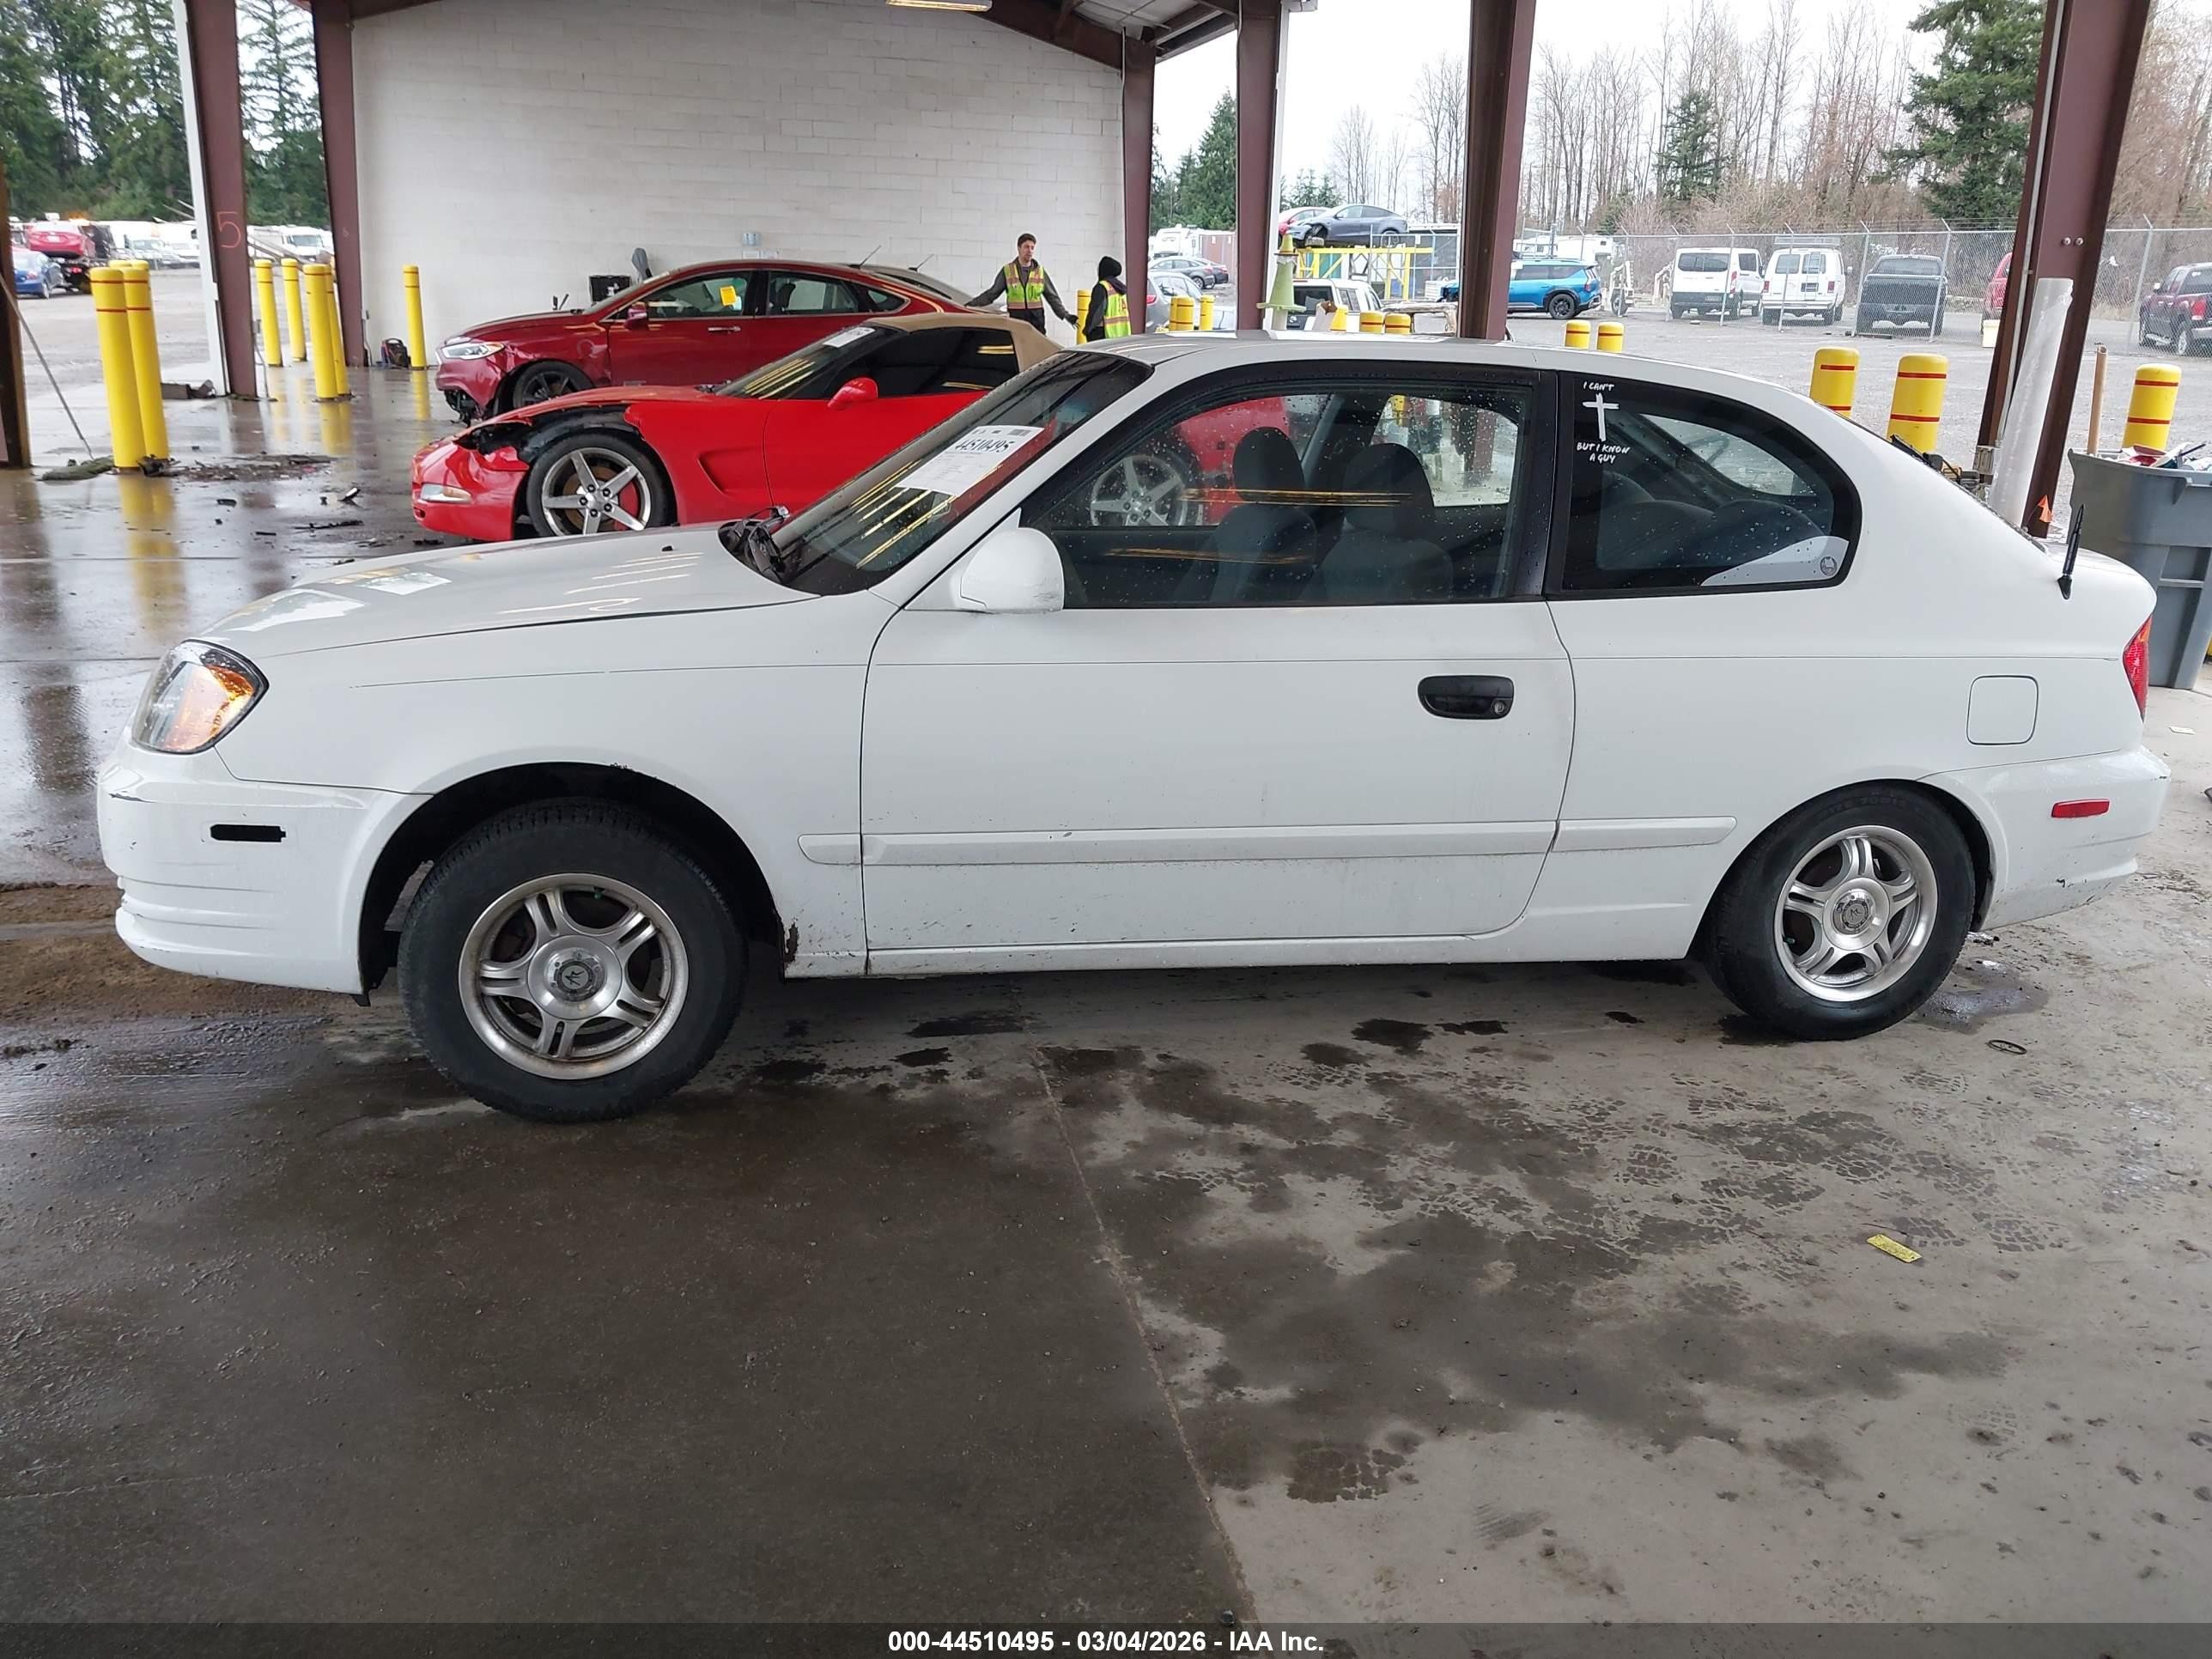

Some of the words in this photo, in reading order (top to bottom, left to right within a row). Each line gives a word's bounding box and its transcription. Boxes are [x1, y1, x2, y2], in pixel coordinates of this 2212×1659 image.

[216, 210, 241, 248] 5
[1589, 382, 1614, 391] CAN'T
[1577, 442, 1595, 451] BUT
[1601, 444, 1631, 454] KNOW
[1589, 453, 1595, 462] A
[1597, 454, 1616, 464] GUY
